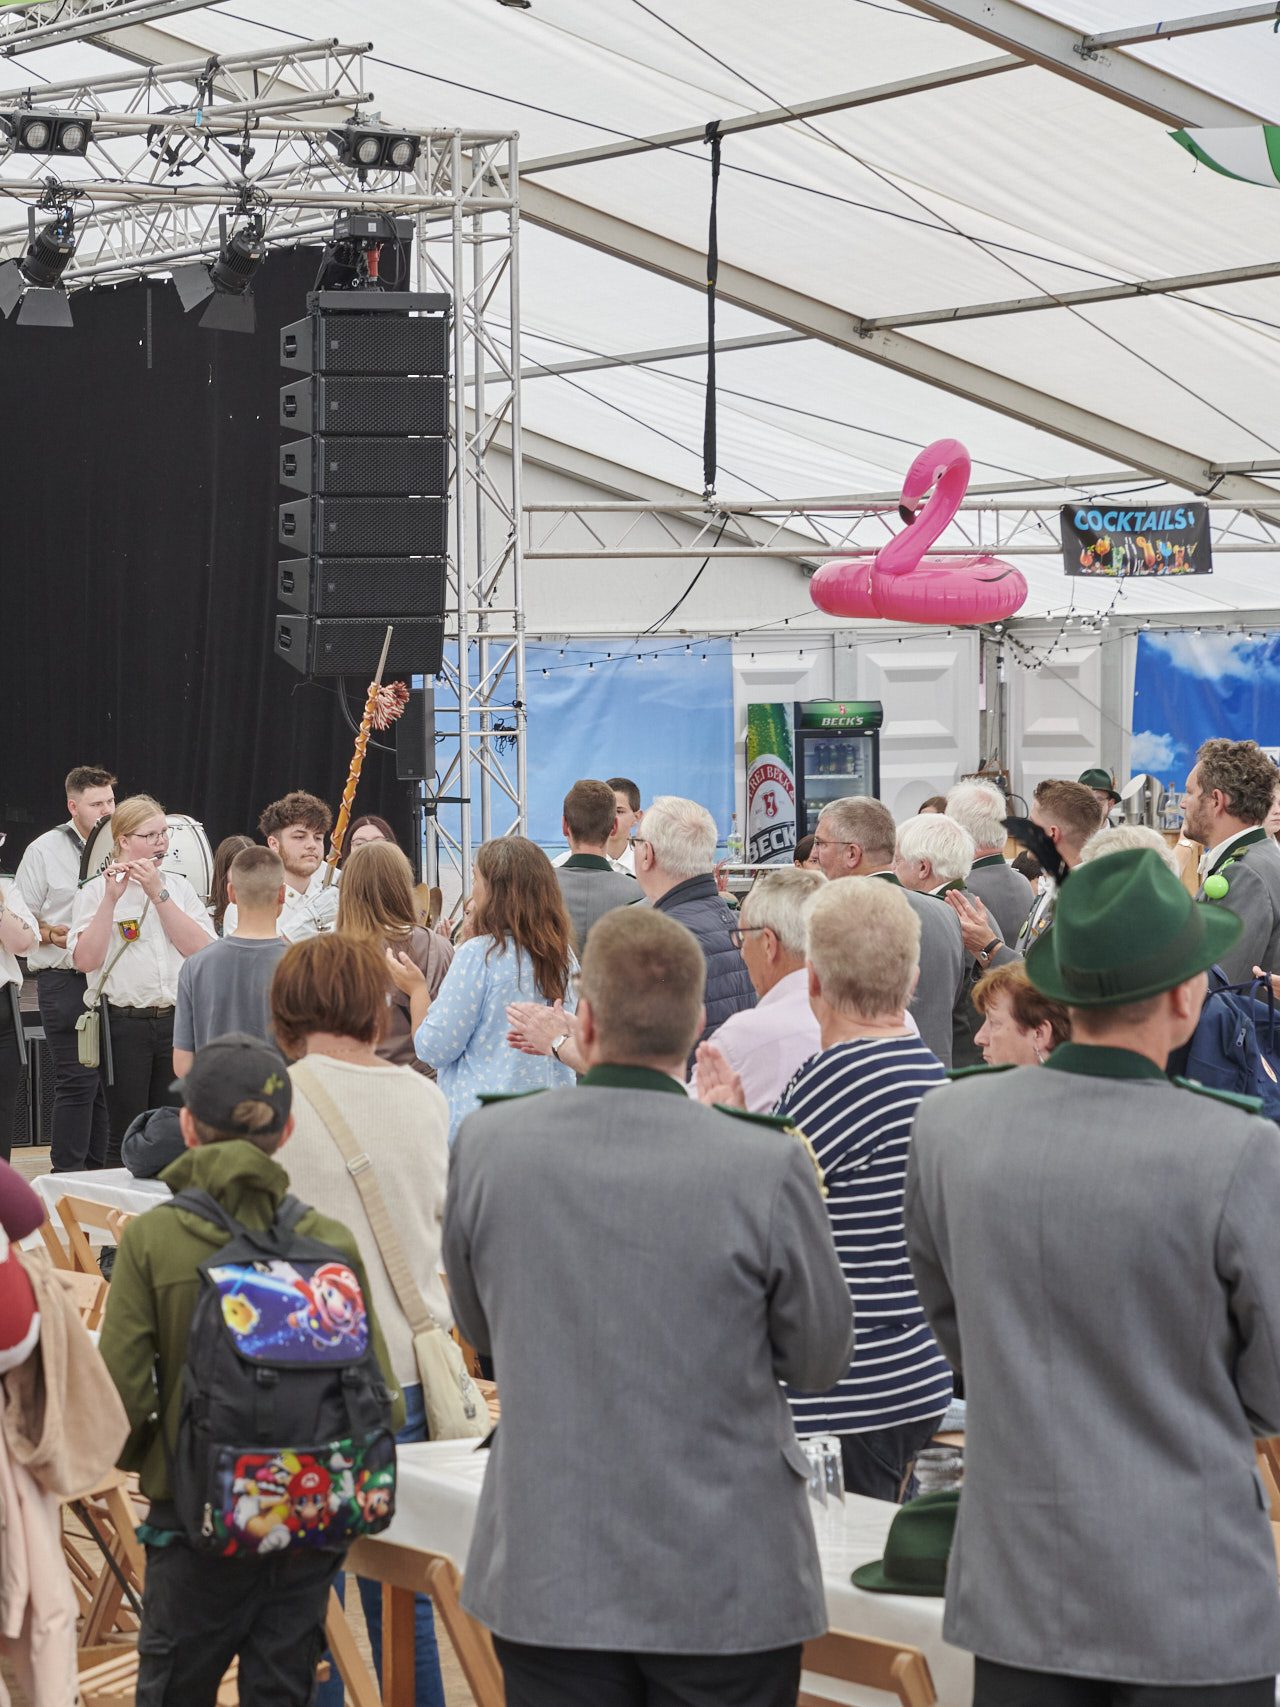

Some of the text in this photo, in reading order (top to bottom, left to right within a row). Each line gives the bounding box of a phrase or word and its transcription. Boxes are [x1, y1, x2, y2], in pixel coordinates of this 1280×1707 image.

[1074, 508, 1188, 532] COCKTAILS
[822, 716, 864, 726] BECK'S
[767, 765, 790, 790] BECK
